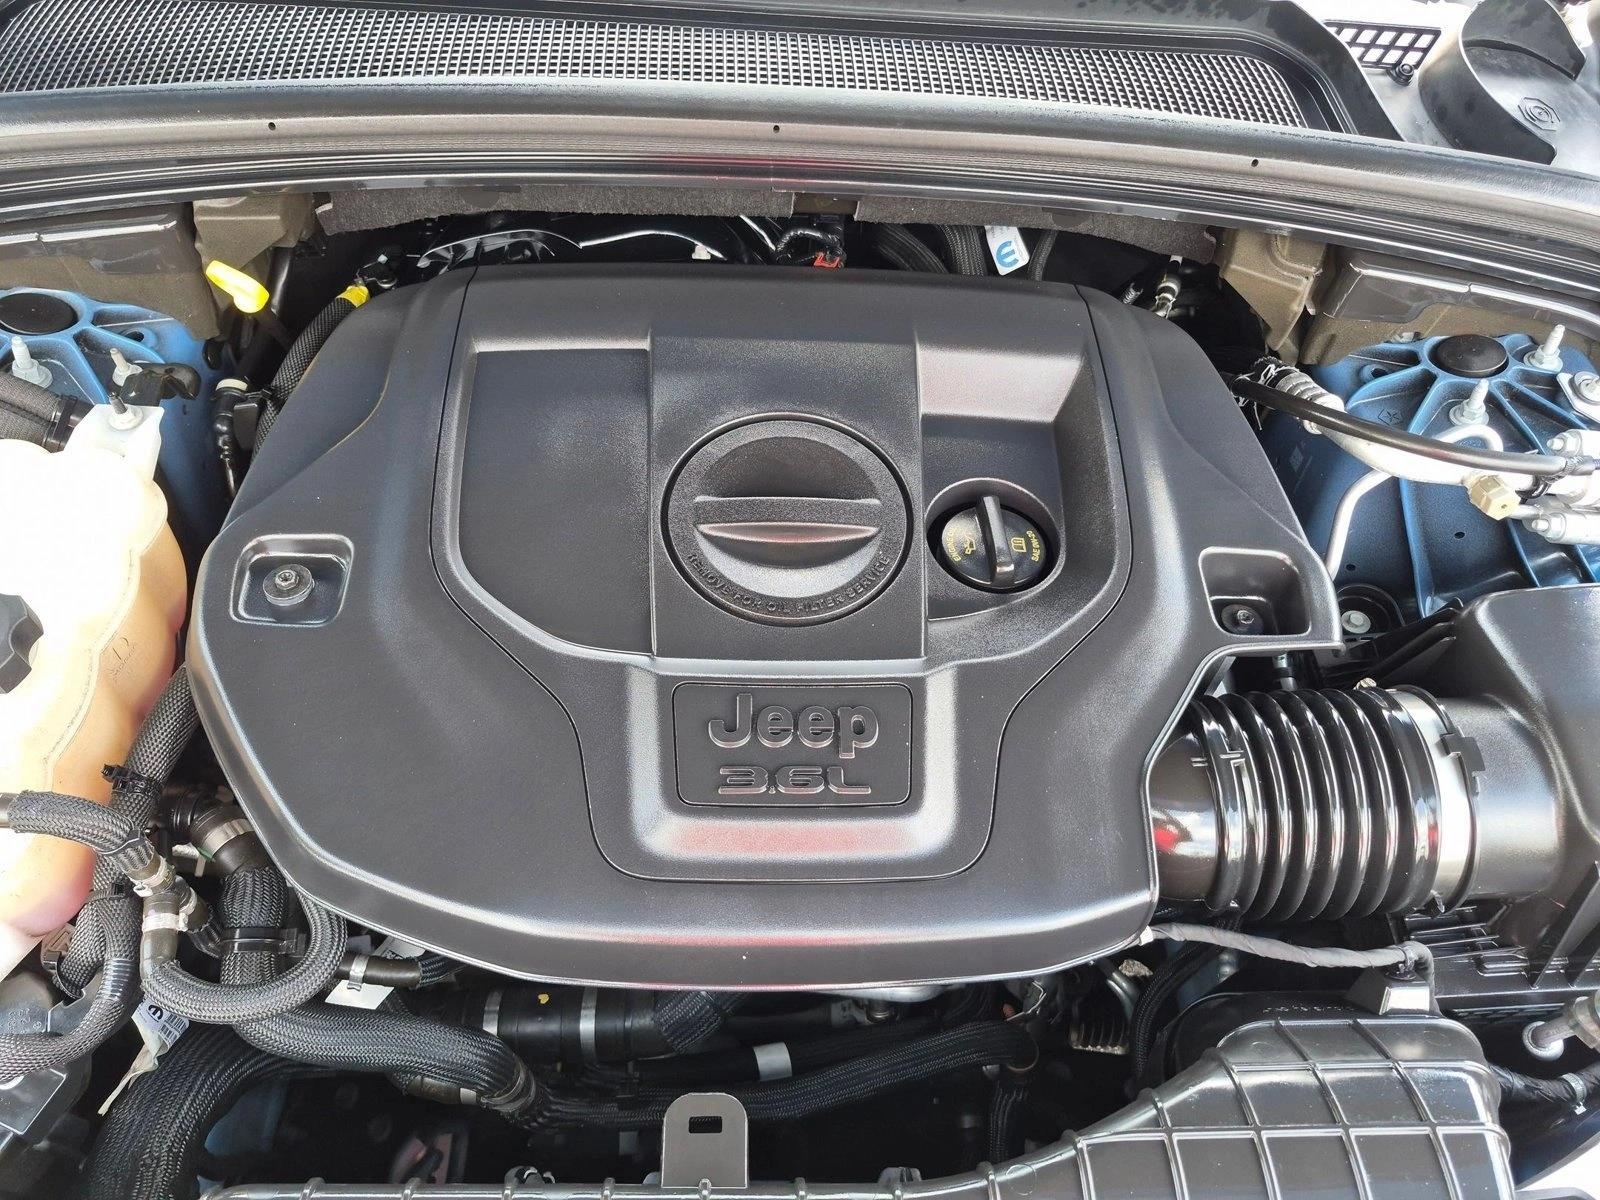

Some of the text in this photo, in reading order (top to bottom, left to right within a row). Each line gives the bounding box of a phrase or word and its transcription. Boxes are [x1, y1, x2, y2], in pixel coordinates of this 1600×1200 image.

[1031, 548, 1040, 562] SAE
[846, 551, 890, 598] SERVICE
[708, 692, 879, 758] Jeep
[718, 765, 872, 795] 3.6L
